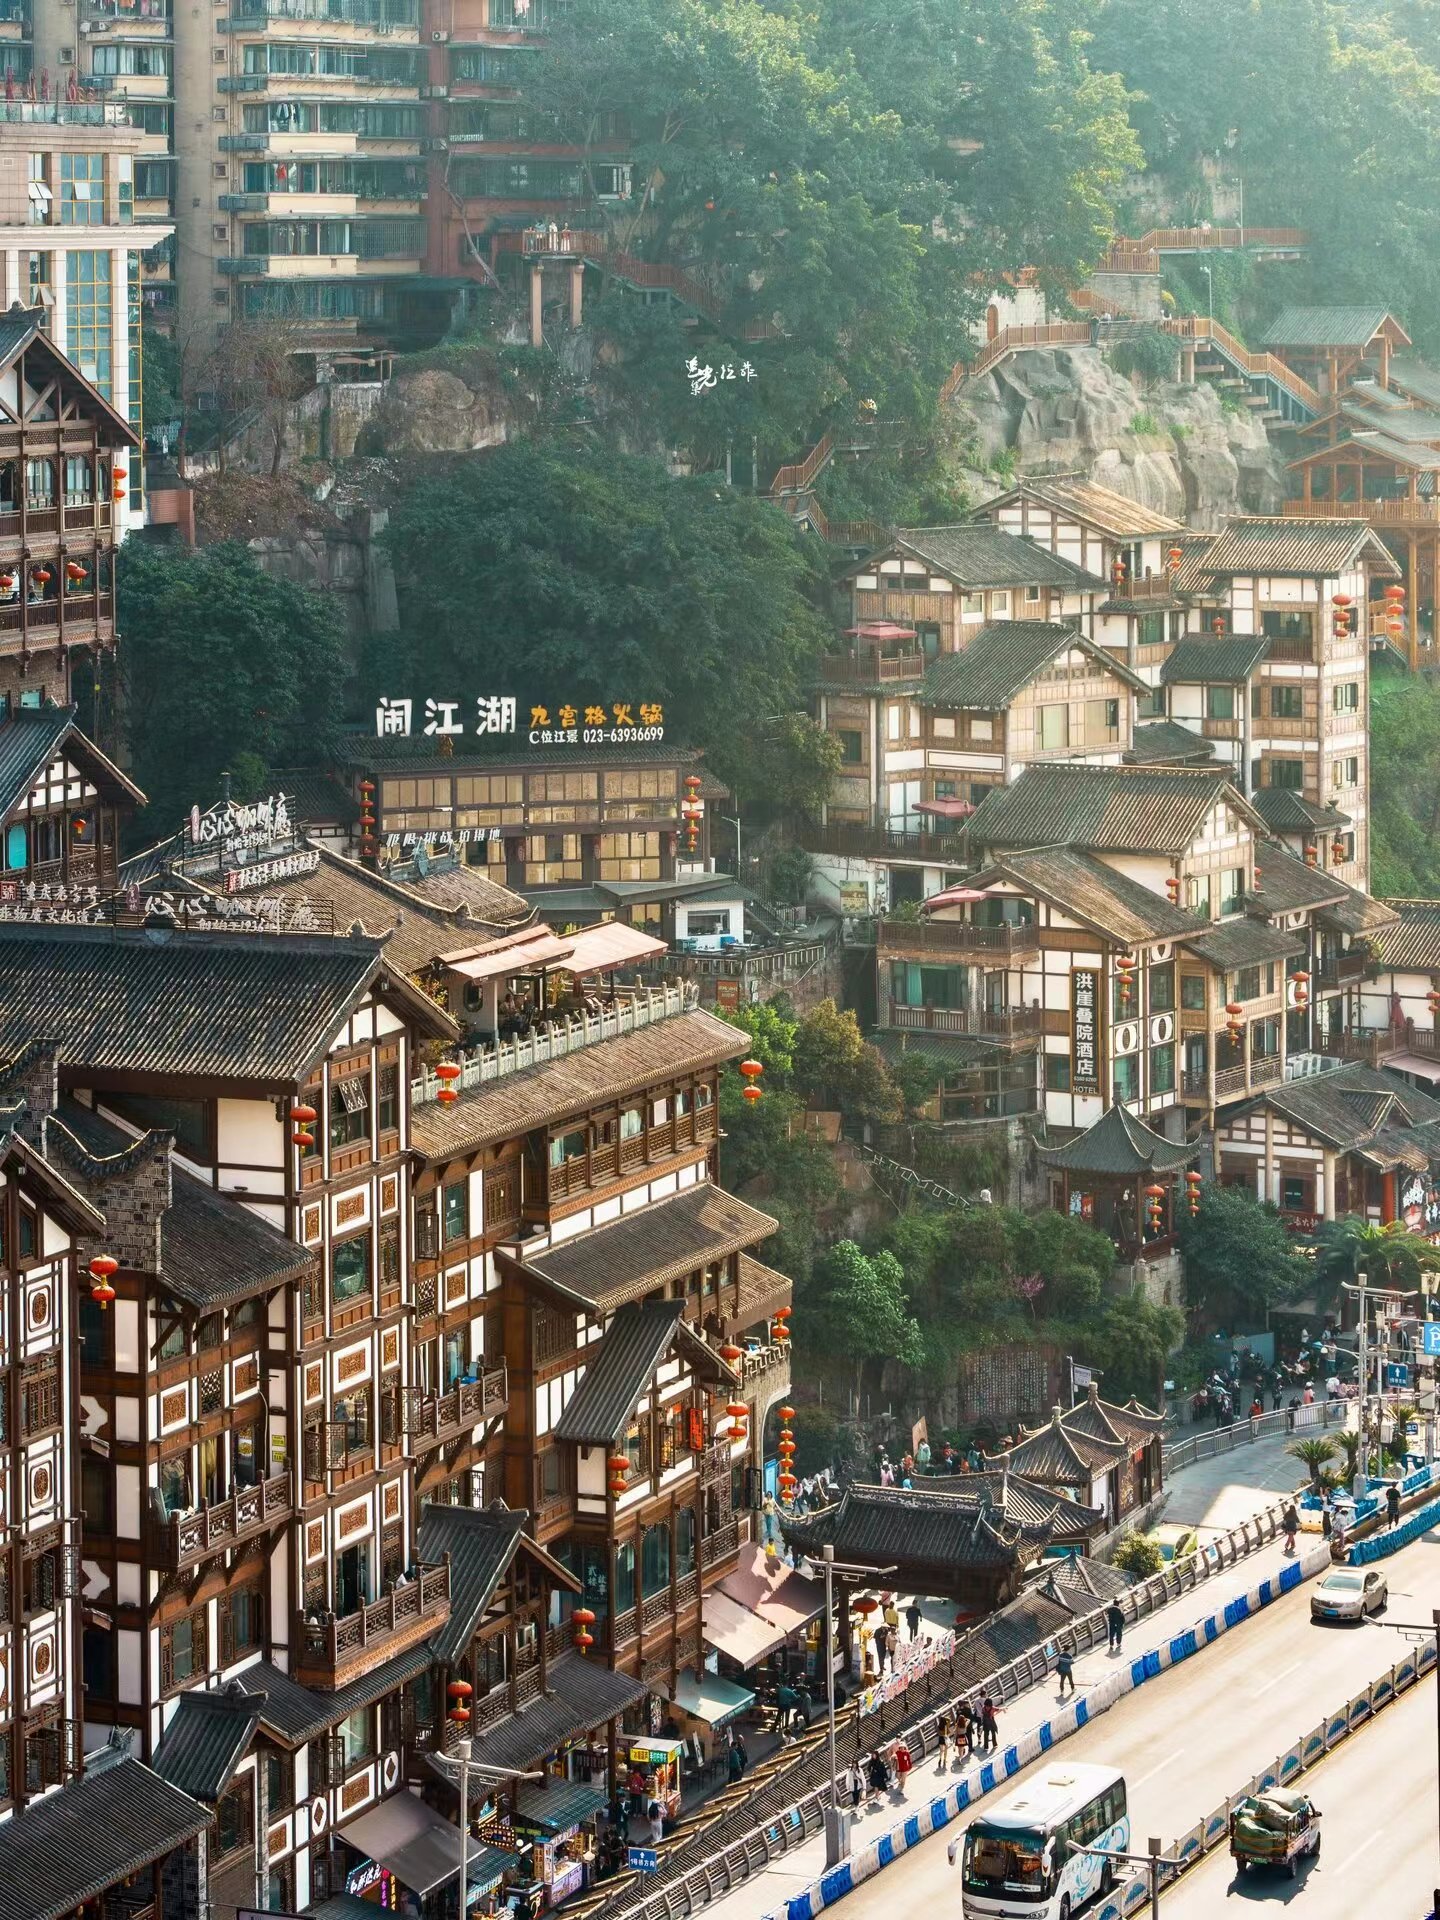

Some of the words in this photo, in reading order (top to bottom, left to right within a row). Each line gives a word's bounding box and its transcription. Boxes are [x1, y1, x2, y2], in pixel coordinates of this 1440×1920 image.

[376, 696, 516, 737] 闹江湖
[530, 703, 663, 728] 九宫格火锅
[528, 729, 578, 744] C位江景
[583, 727, 664, 744] 023-63936699
[1076, 972, 1093, 1076] 洪崖叠院酒店
[1072, 1085, 1098, 1095] HOTEL
